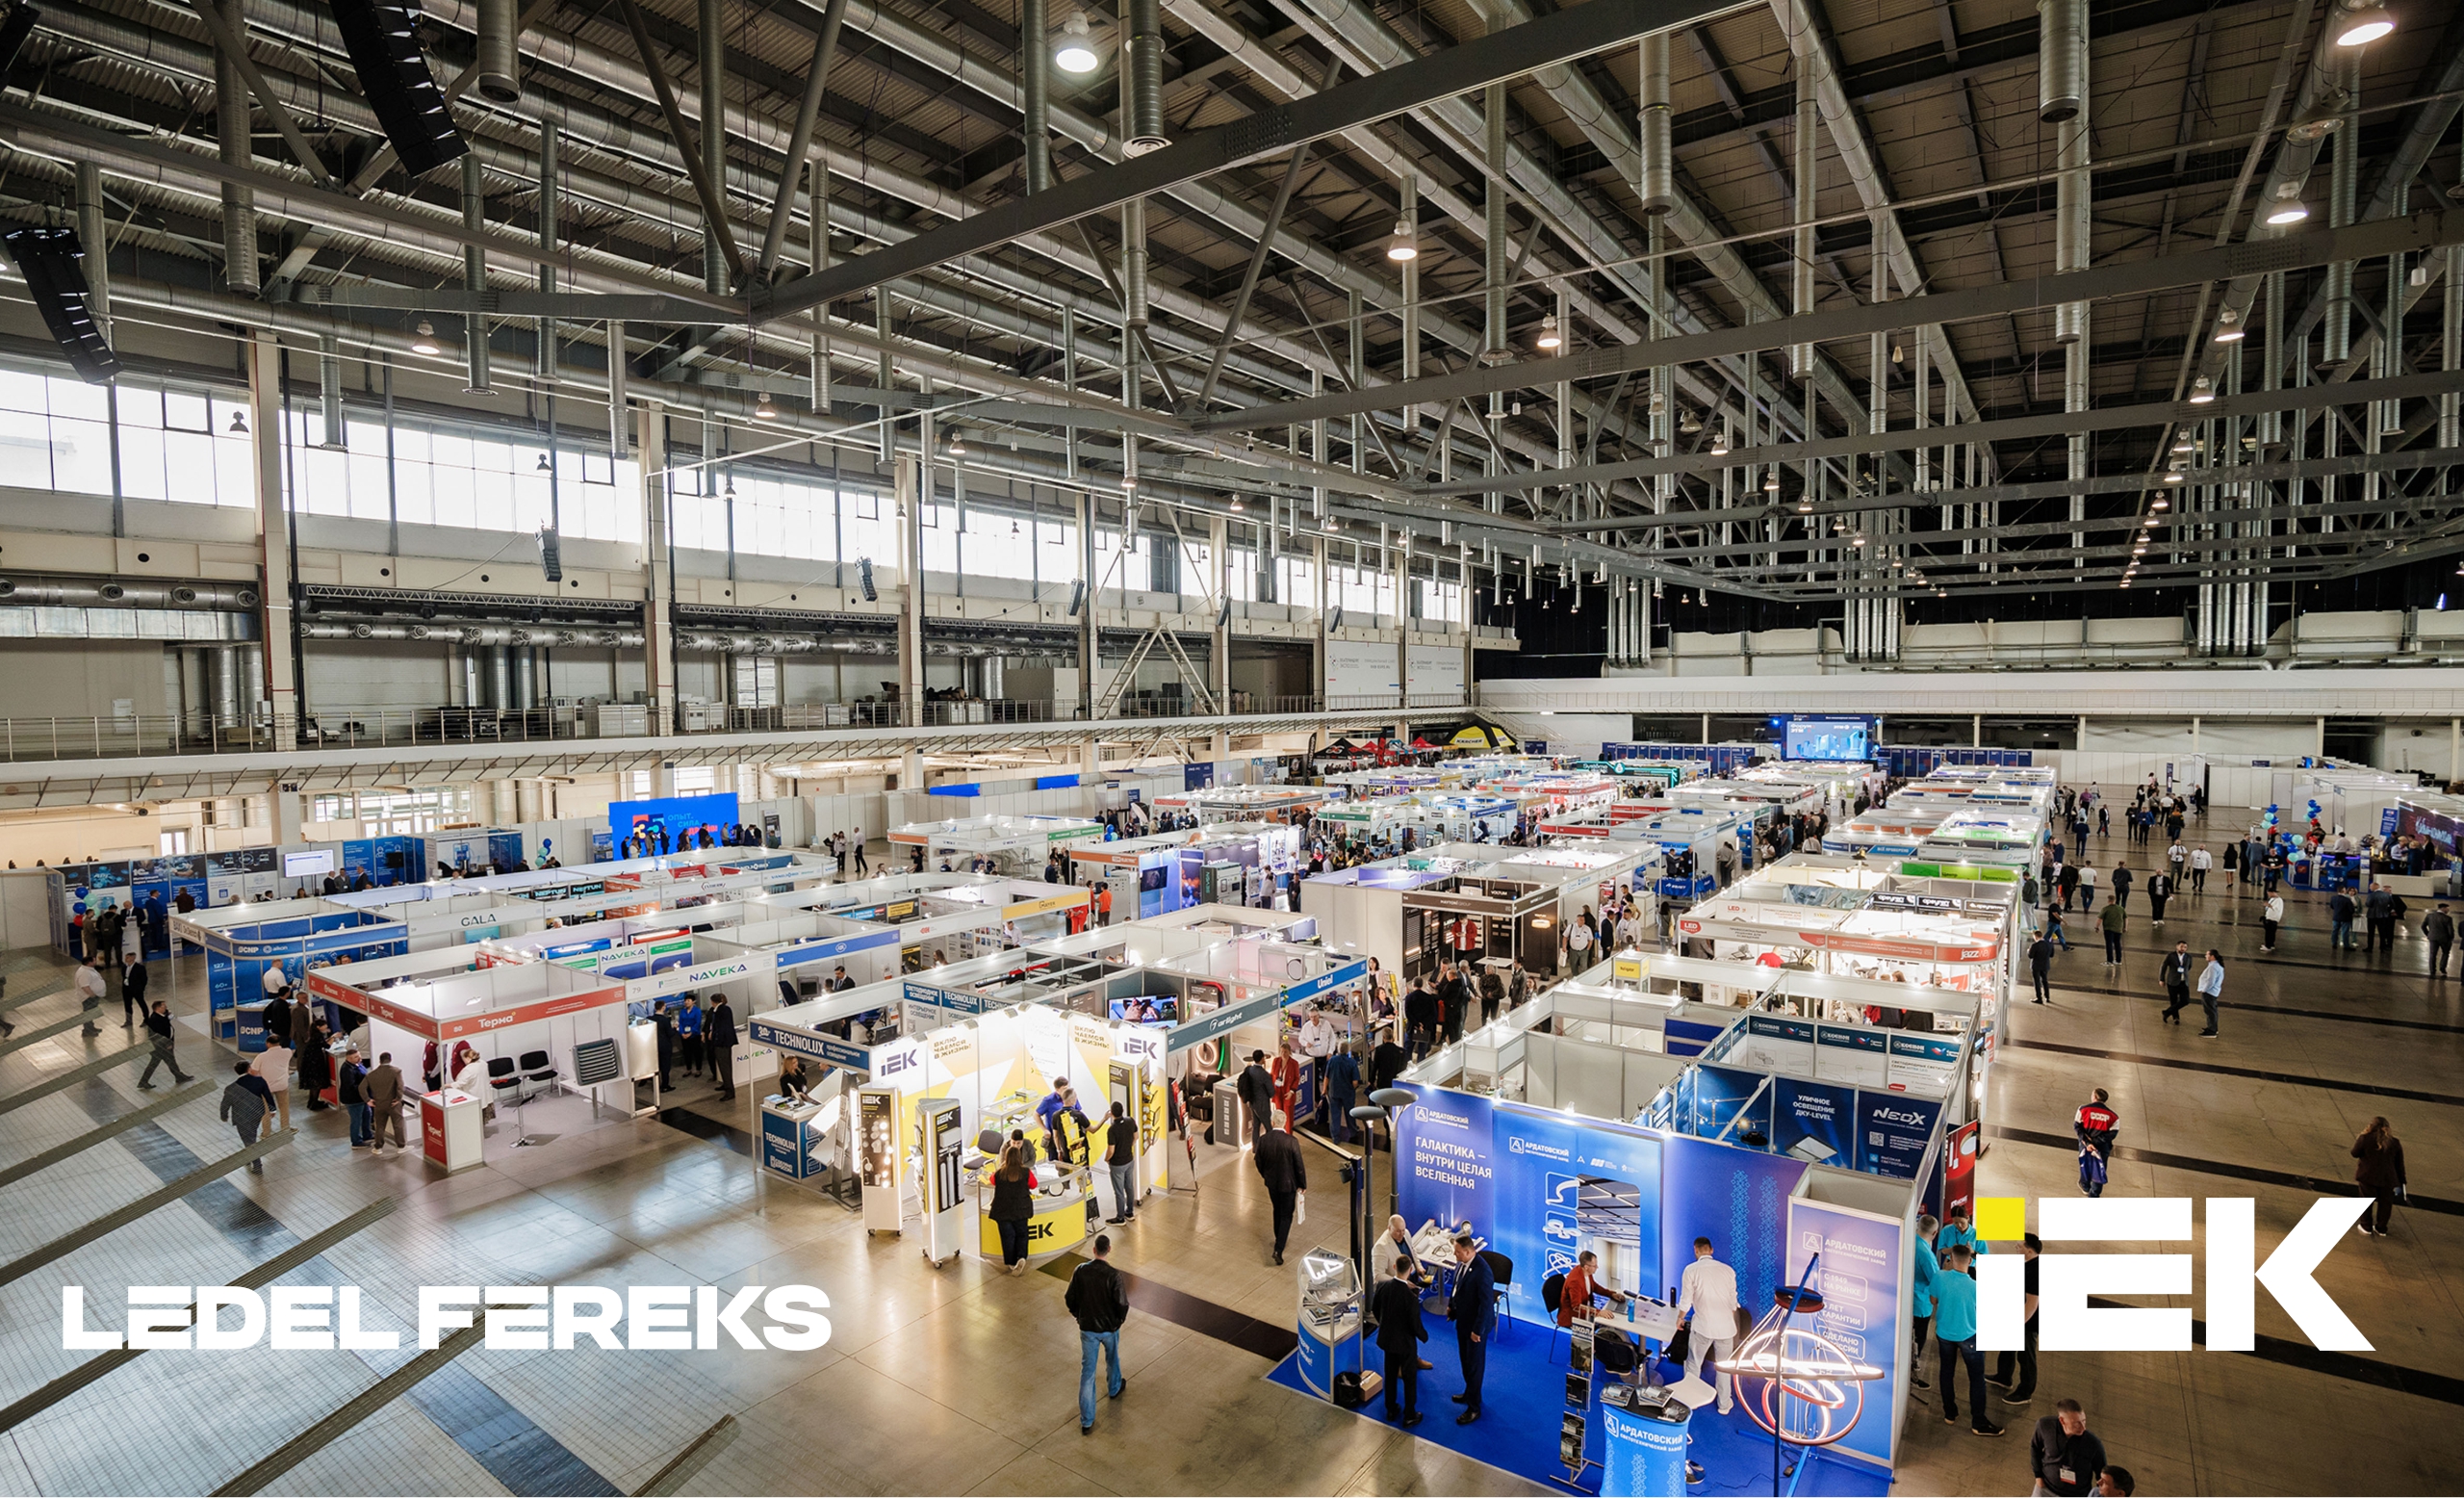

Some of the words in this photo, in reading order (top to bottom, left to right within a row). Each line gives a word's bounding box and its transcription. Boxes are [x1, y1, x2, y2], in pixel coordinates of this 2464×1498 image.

[534, 888, 567, 897] NEPTUN
[573, 883, 603, 893] NEPTUN
[460, 913, 497, 927] GALA
[601, 948, 646, 962] NAVEKA
[689, 964, 748, 983] NAVEKA
[1317, 974, 1333, 989] Uniel
[631, 986, 642, 994] 79
[943, 991, 979, 1006] TECHNOLUX
[477, 1015, 514, 1029] Терма
[1217, 1012, 1243, 1027] arlight
[245, 1027, 265, 1036] CNP
[1074, 1025, 1095, 1034] ВКЛЮ
[1074, 1031, 1105, 1042] ЧАЕМСЯ
[774, 1029, 825, 1056] TECHNOLUX
[934, 1036, 957, 1047] ВКЛЮ
[934, 1039, 966, 1053] ЧАЕМСЯ
[736, 1048, 772, 1062] NAVEKA
[1792, 1101, 1835, 1114] ОСВЕЩЕНИЕ
[1797, 1095, 1831, 1106] УЛИЧНОЕ
[1429, 1110, 1469, 1125] АРДАТОВСКИЙ
[1795, 1109, 1832, 1122] ДКУ-LEVEL
[2090, 1111, 2110, 1122] СССР
[765, 1131, 796, 1151] TECHNOLUX
[1415, 1136, 1476, 1160] ГАЛАКТИКА
[1525, 1141, 1570, 1157] АРДАТОВСКИЙ
[1415, 1151, 1455, 1170] ВНУТРИ
[1457, 1161, 1492, 1179] ЦЕЛАЯ
[1415, 1165, 1476, 1190] ВСЕЛЕННАЯ
[1027, 1222, 1054, 1240] EK
[1824, 1239, 1886, 1259] АРДАТОВСКИЙ
[1831, 1274, 1848, 1285] 1949
[1823, 1281, 1835, 1291] НА
[1835, 1283, 1861, 1297] РЫНКЕ
[1829, 1303, 1844, 1312] ЛЕТ
[1822, 1310, 1861, 1327] ГАРАНТИИ
[1822, 1330, 1860, 1347] СДЕЛАНО
[1620, 1424, 1683, 1445] АРДАТОВСКИЙ
[1620, 1433, 1667, 1452] СВЕТОТЕХНИЧЕСКИЙ
[1668, 1443, 1682, 1452] ЗАВОД
